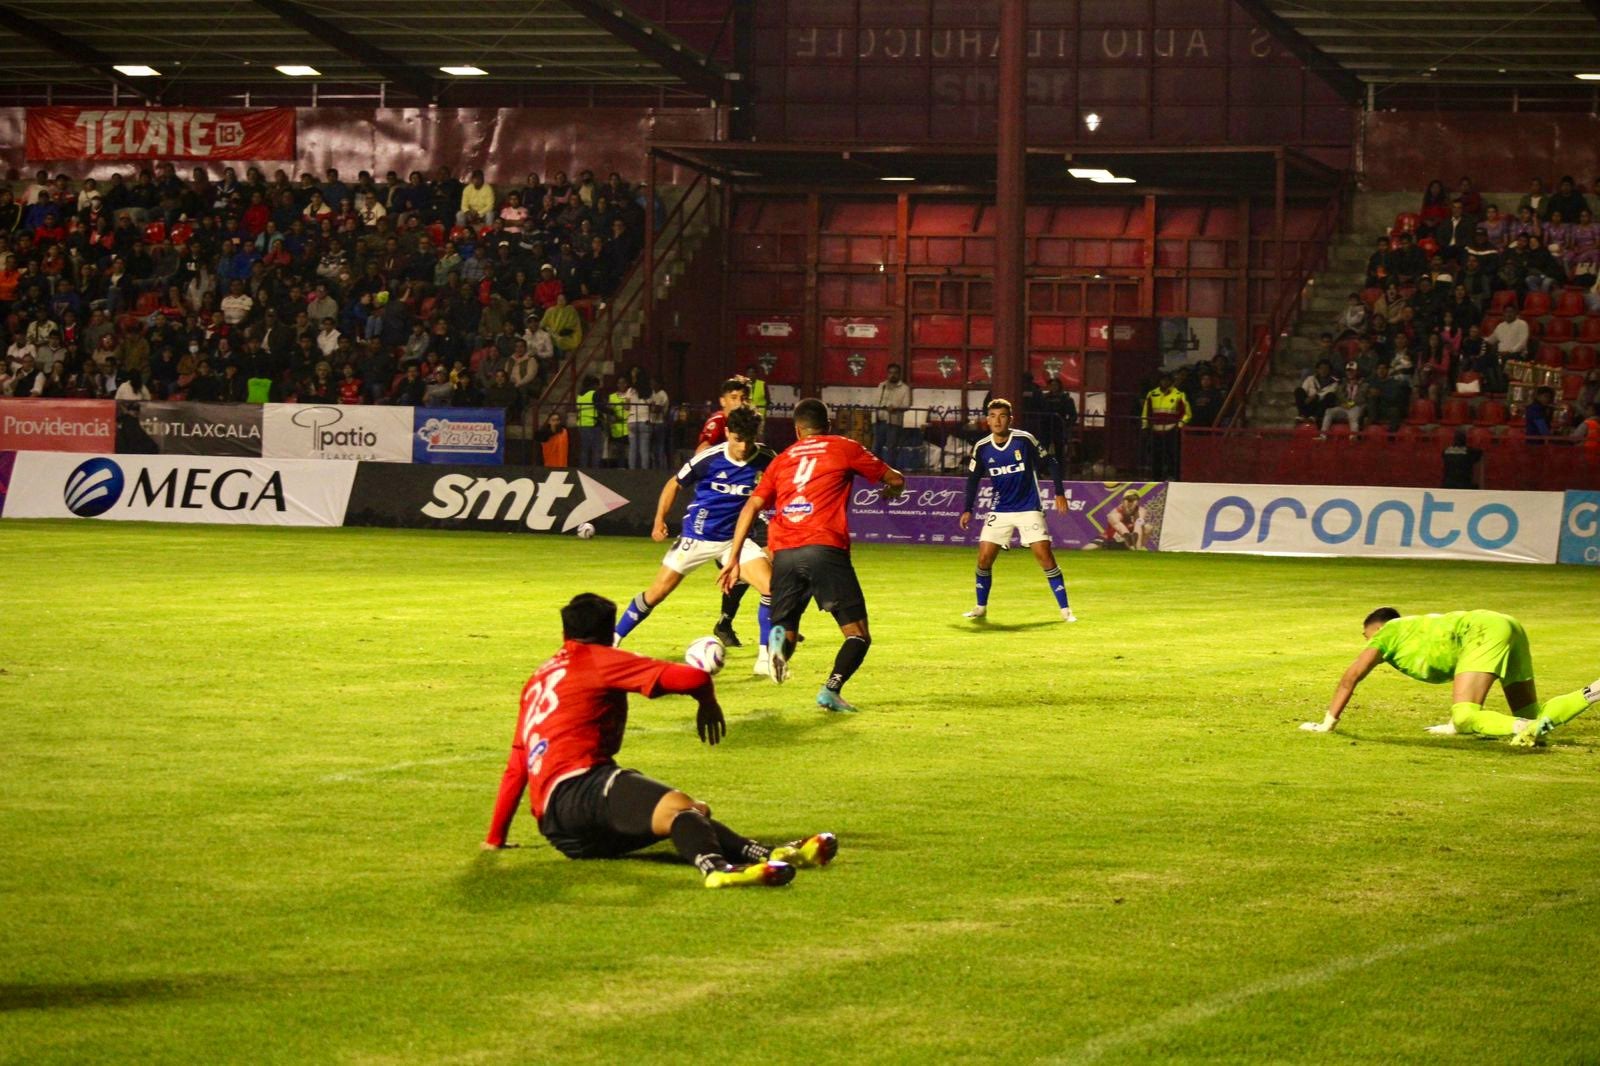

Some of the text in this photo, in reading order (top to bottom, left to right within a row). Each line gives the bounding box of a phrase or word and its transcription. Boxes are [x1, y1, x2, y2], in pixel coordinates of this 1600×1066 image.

[74, 111, 216, 155] TECATE
[4, 416, 110, 436] Providencia
[320, 427, 377, 450] patio
[793, 456, 817, 493] 4
[989, 463, 1026, 476] DIGI
[128, 467, 286, 511] MEGA
[420, 471, 574, 530] smt
[711, 482, 754, 496] DIG
[1201, 492, 1519, 551] pronto
